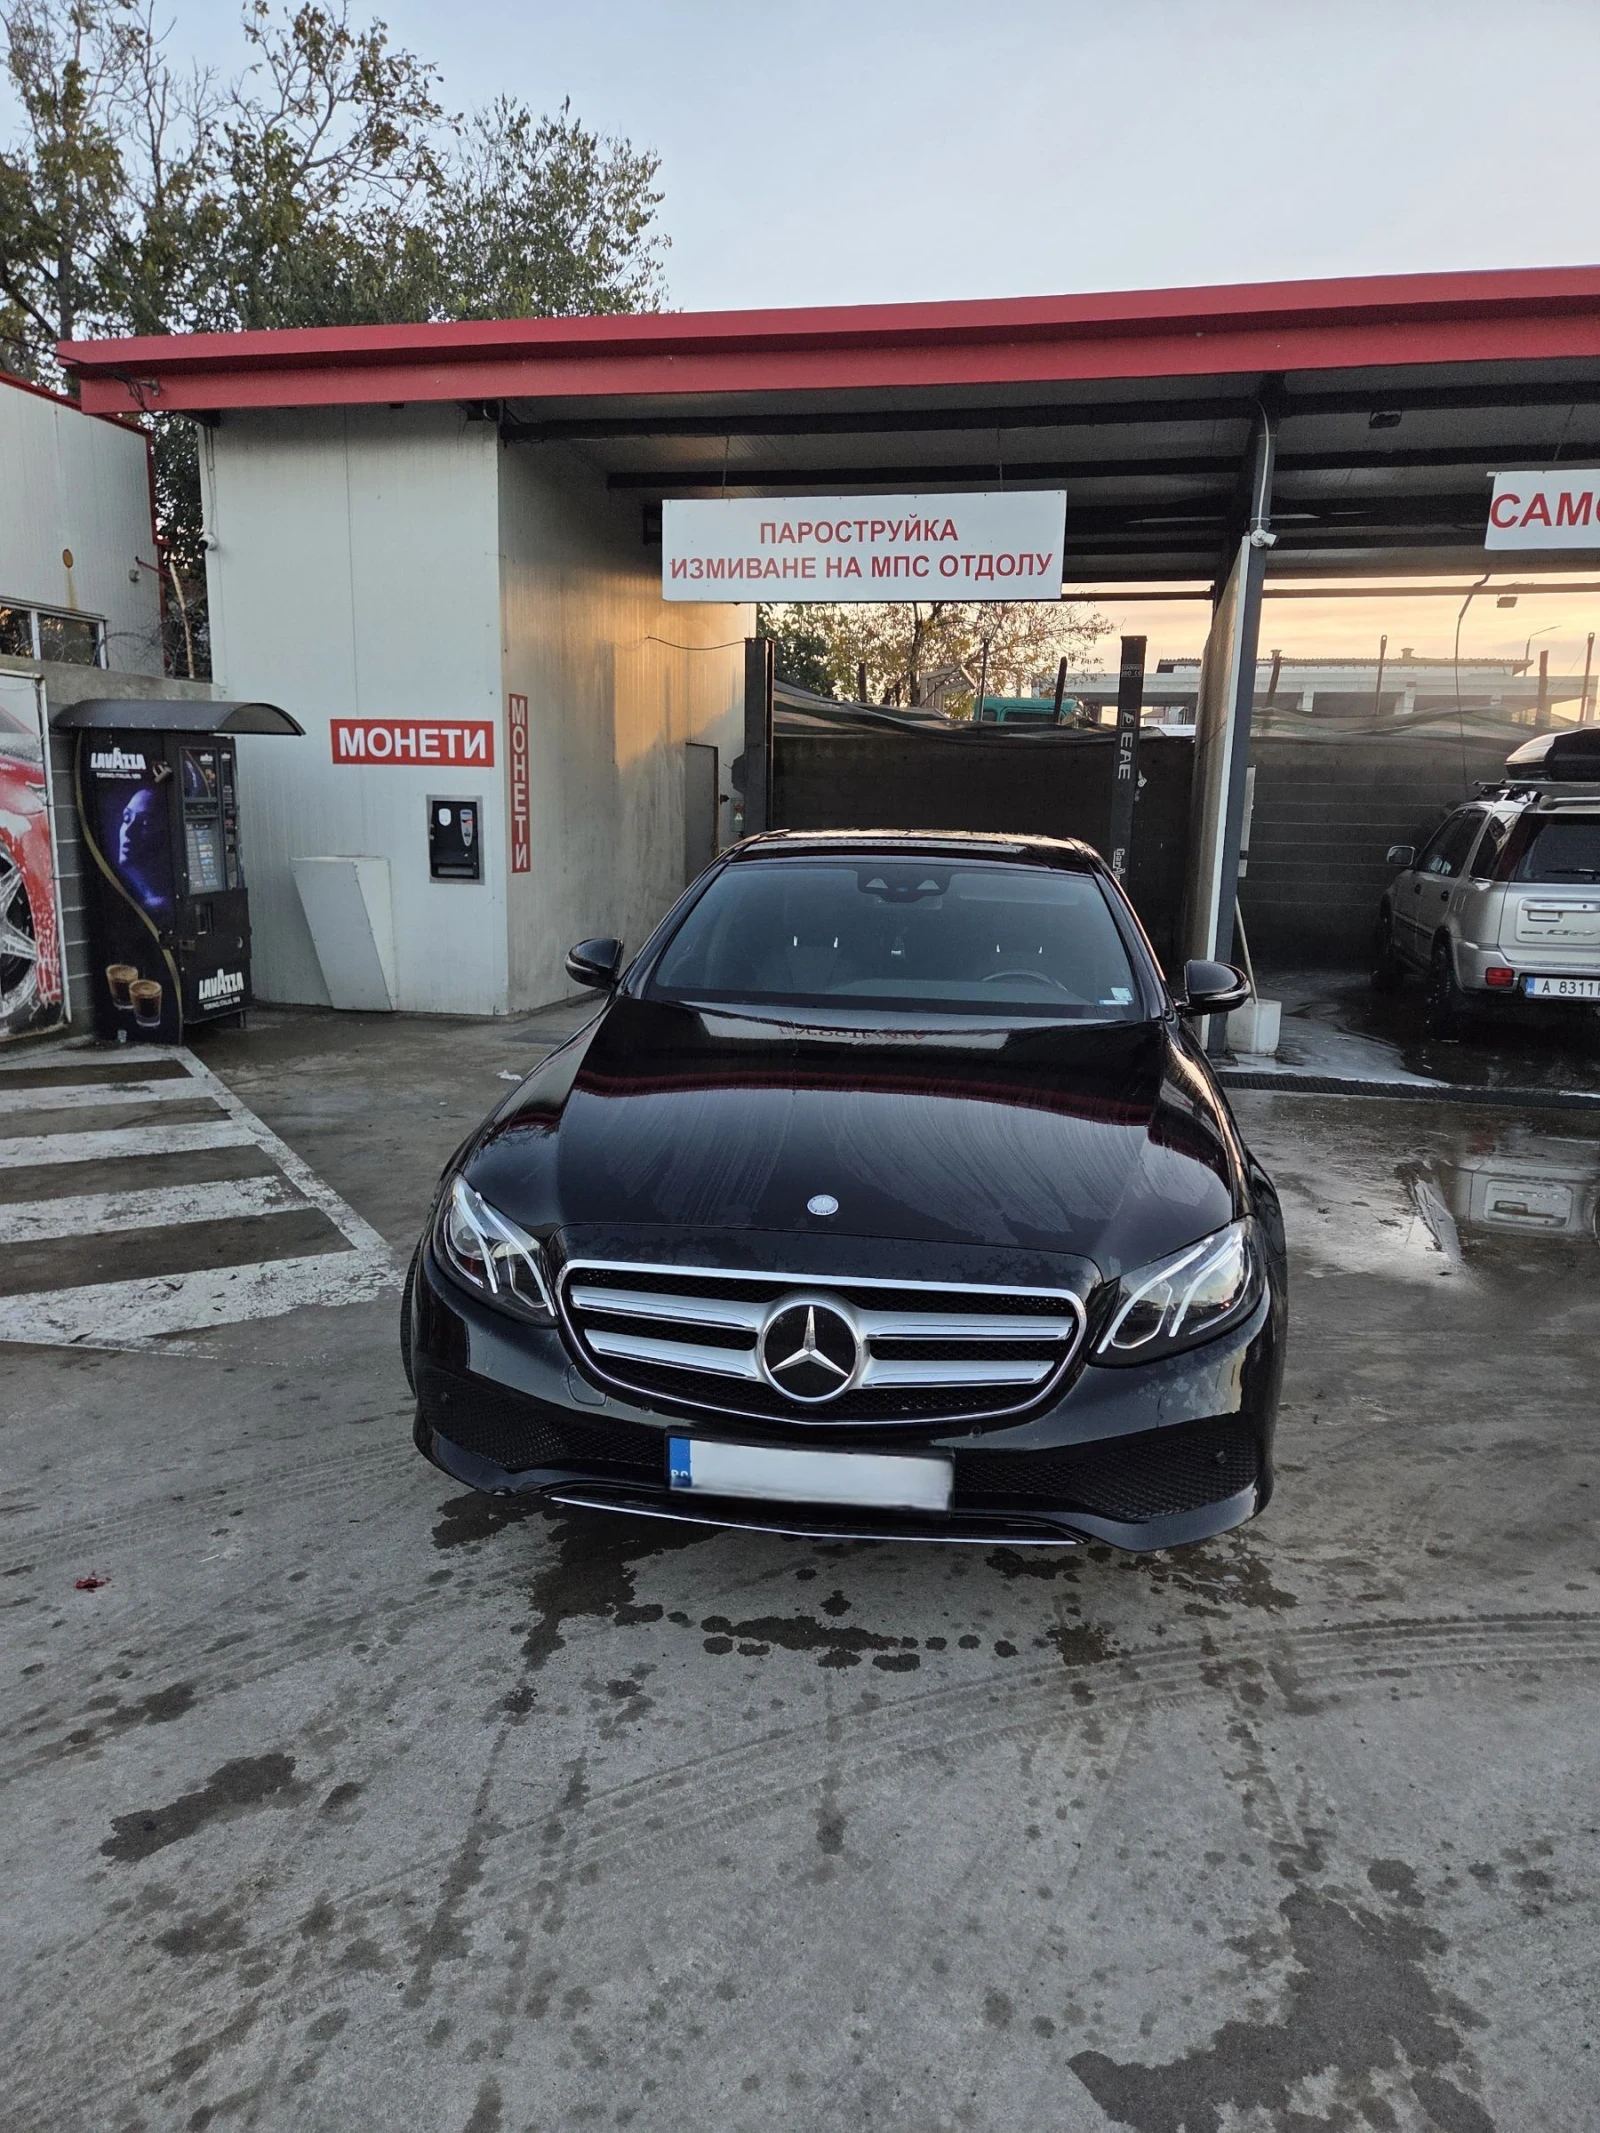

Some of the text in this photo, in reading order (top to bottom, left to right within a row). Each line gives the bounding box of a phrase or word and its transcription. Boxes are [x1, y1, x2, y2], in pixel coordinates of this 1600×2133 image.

[1490, 491, 1600, 529] САМ
[760, 513, 959, 544] ПАРОСТРУЙКА
[671, 553, 1053, 582] ИЗМИВАНЕ НА МПС ОТДОЛУ
[338, 726, 487, 760] МОНЕТИ
[1117, 732, 1133, 780] EAE
[511, 697, 528, 869] МОНЕТИ
[1541, 980, 1600, 996] A 8311
